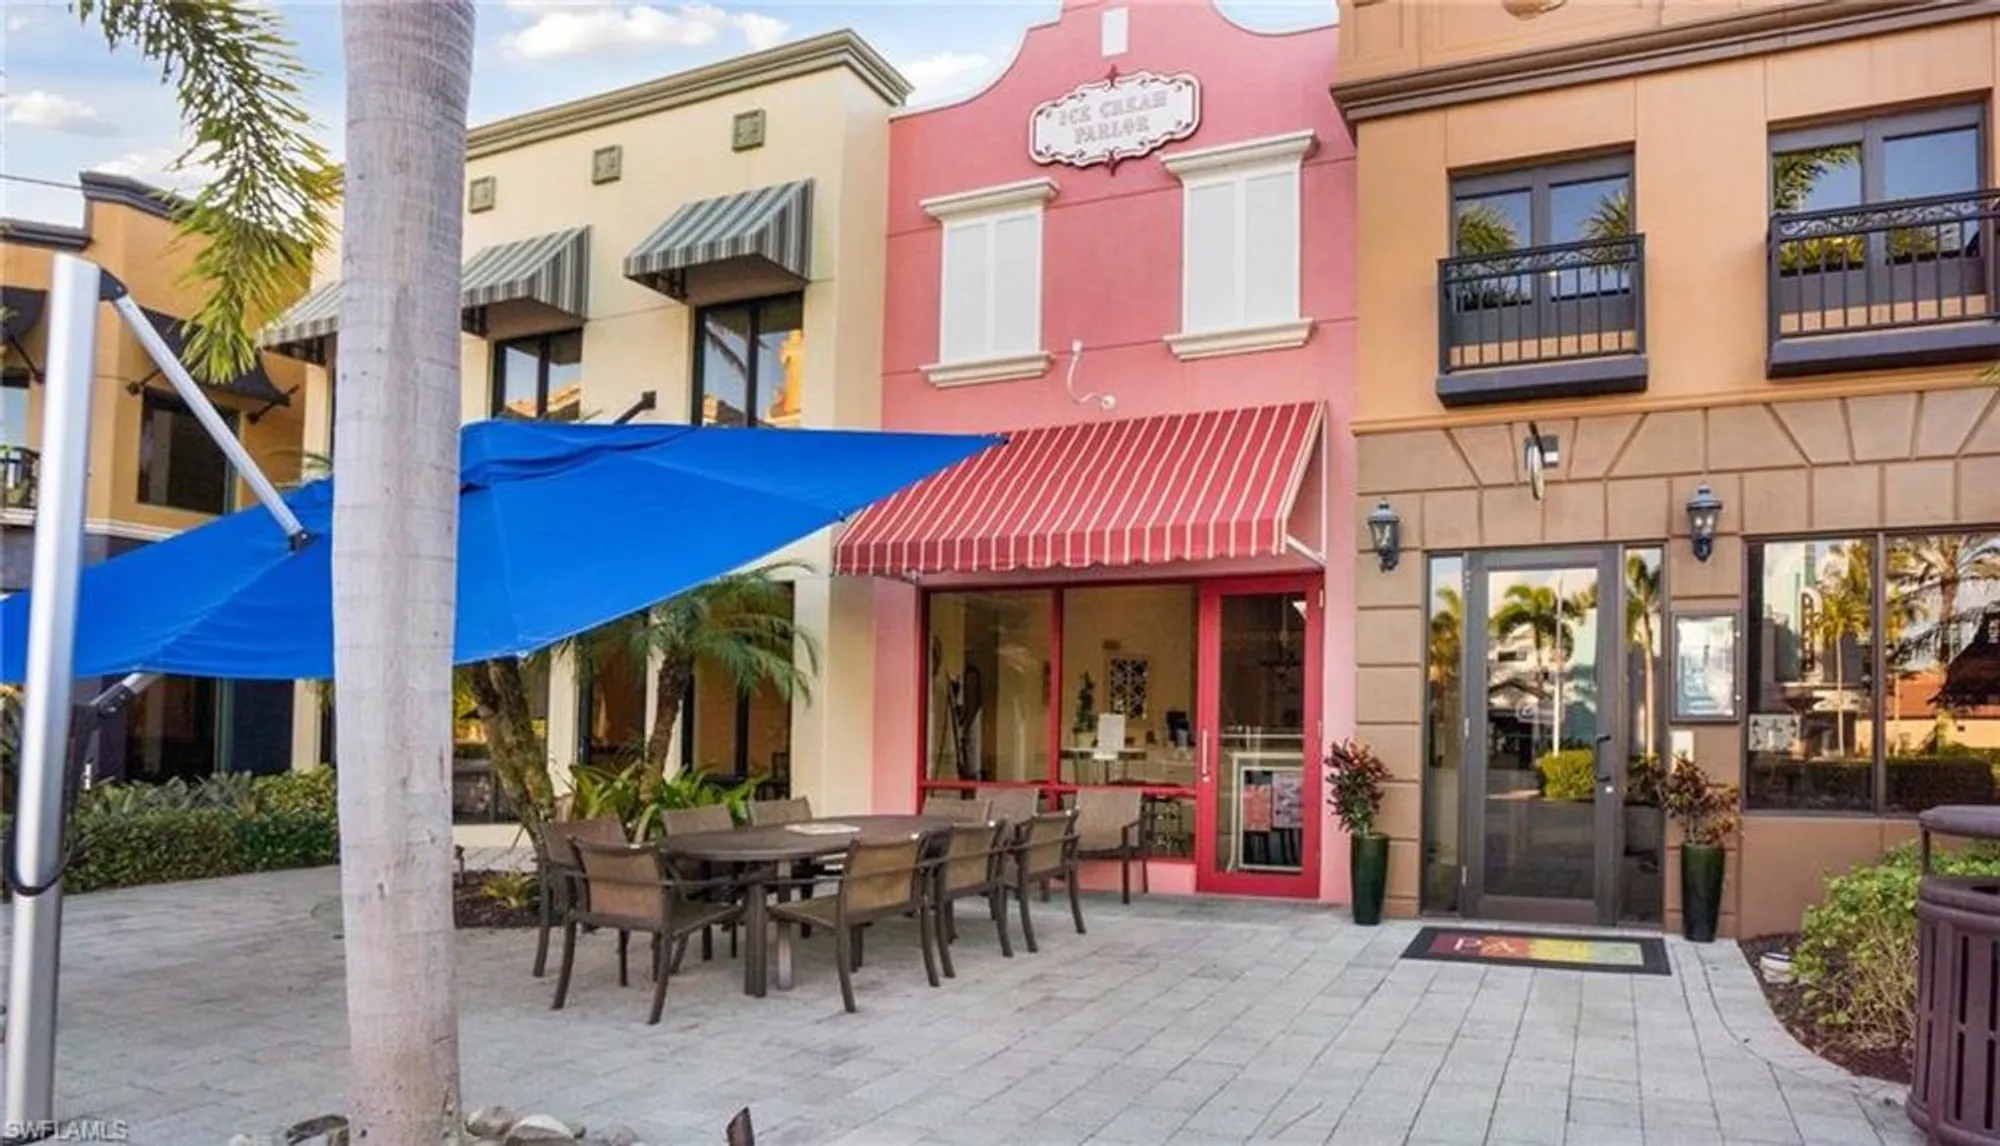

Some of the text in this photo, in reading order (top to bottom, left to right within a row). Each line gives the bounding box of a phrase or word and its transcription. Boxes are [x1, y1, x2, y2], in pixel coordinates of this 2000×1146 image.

[1057, 90, 1168, 126] ICE CREAM
[1074, 115, 1150, 144] PARLOR
